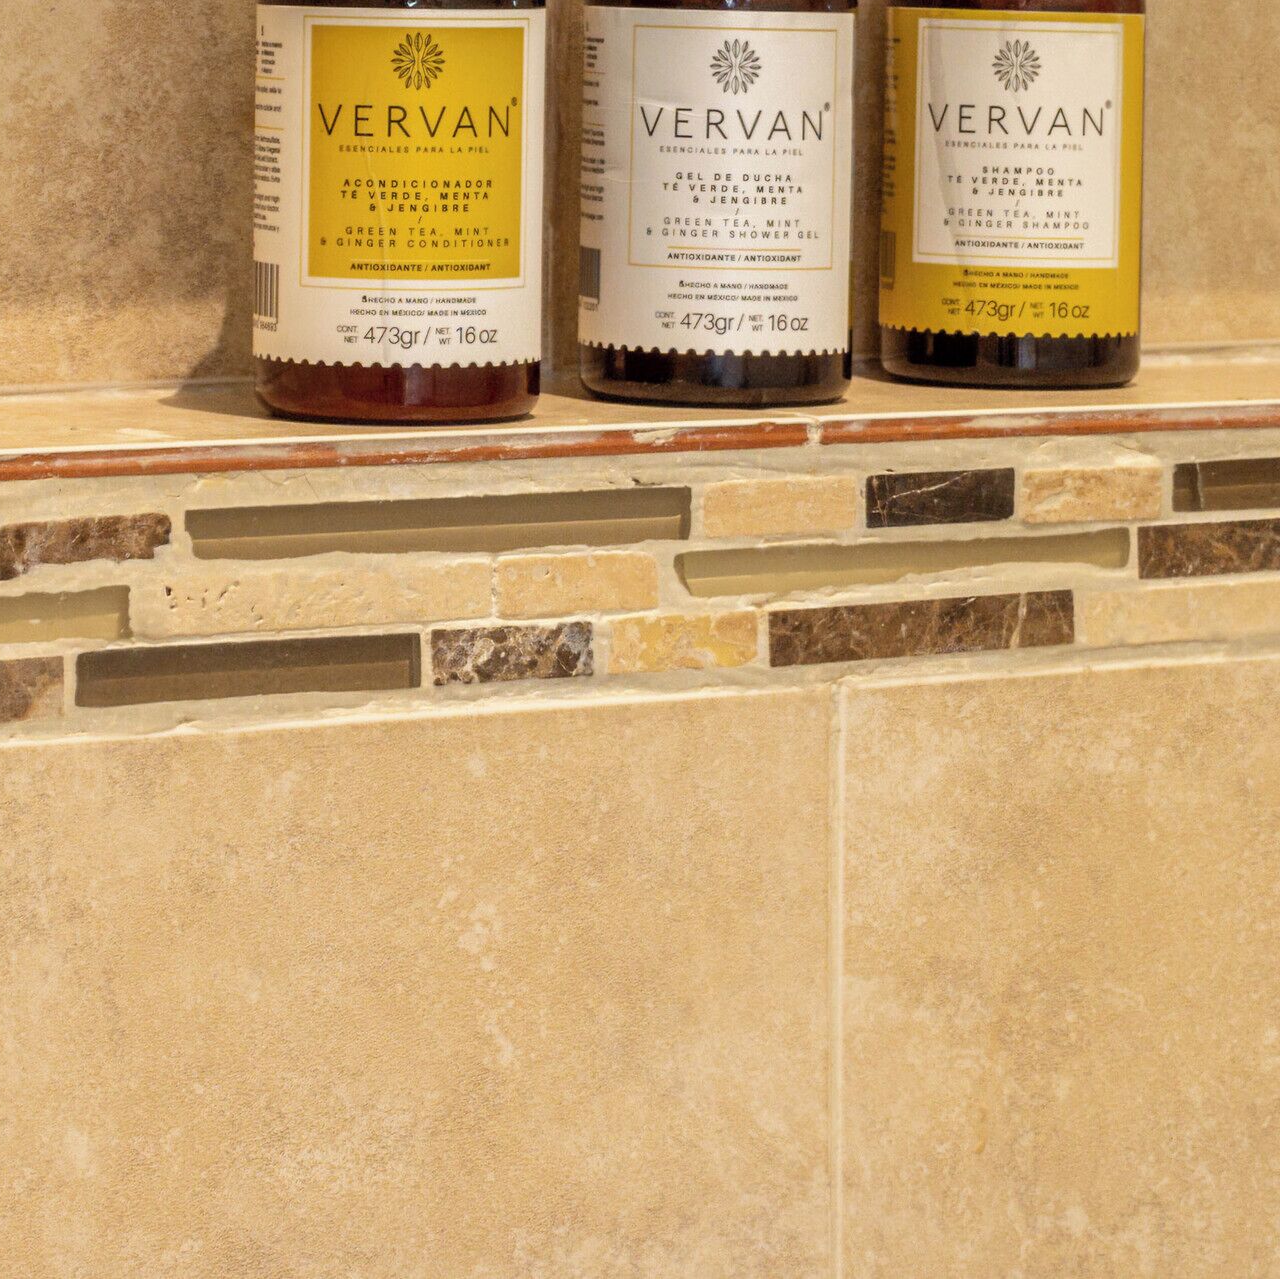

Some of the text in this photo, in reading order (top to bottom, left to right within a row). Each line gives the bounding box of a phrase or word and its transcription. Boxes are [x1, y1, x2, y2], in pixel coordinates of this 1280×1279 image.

[318, 103, 509, 137] VERVAN
[640, 106, 823, 141] VERVAN
[928, 103, 1104, 136] VERVAN
[339, 145, 409, 153] ESENCIALES
[659, 145, 726, 154] ESENCIALES
[945, 140, 1008, 149] ESENCIALES
[1013, 142, 1039, 150] PARA
[1062, 143, 1083, 151] PIEL
[982, 166, 1055, 175] SHAMPOO
[675, 172, 792, 182] GEL DE DUCHA
[947, 175, 1083, 187] TÉ VERDE, MENTA
[343, 179, 493, 188] ACONDICIONADOR
[662, 182, 803, 194] TÉ VERDE, MENTA
[340, 190, 489, 202] TÉ VERDE, MENTA
[972, 187, 1063, 197] & JENGIBRE
[693, 195, 787, 205] & JENGIBRE
[387, 204, 470, 212] JENGIBRE
[948, 208, 993, 217] GREEN
[1046, 210, 1080, 218] MINT
[664, 217, 800, 228] GREEN TEA, MINT
[943, 218, 1090, 230] & GINGER SHAMPOO
[345, 226, 397, 236] GREEN
[454, 227, 489, 235] MINT
[646, 228, 820, 239] & GINGER SHOWER GEL
[320, 238, 510, 248] & GINGER CONDITIONER
[954, 240, 1019, 249] ANTIOXIDANTE
[1027, 242, 1084, 250] ANTIOXIDANT
[667, 253, 735, 261] ANTIOXIDANTE
[743, 254, 801, 262] ANTIOXIDANT
[350, 263, 422, 271] ANTIOXIDANTE
[431, 263, 491, 271] ANTIOXIDANT
[965, 300, 1016, 321] 473gr
[1049, 301, 1068, 318] 16
[1071, 304, 1090, 318] oz
[680, 313, 734, 335] 473gr
[751, 324, 764, 332] WT
[768, 314, 788, 332] 16
[790, 317, 808, 331] oz
[344, 336, 358, 344] NET
[363, 326, 420, 349] 473gr
[439, 337, 451, 345] WT
[456, 326, 476, 344] 16
[479, 329, 497, 344] oz
